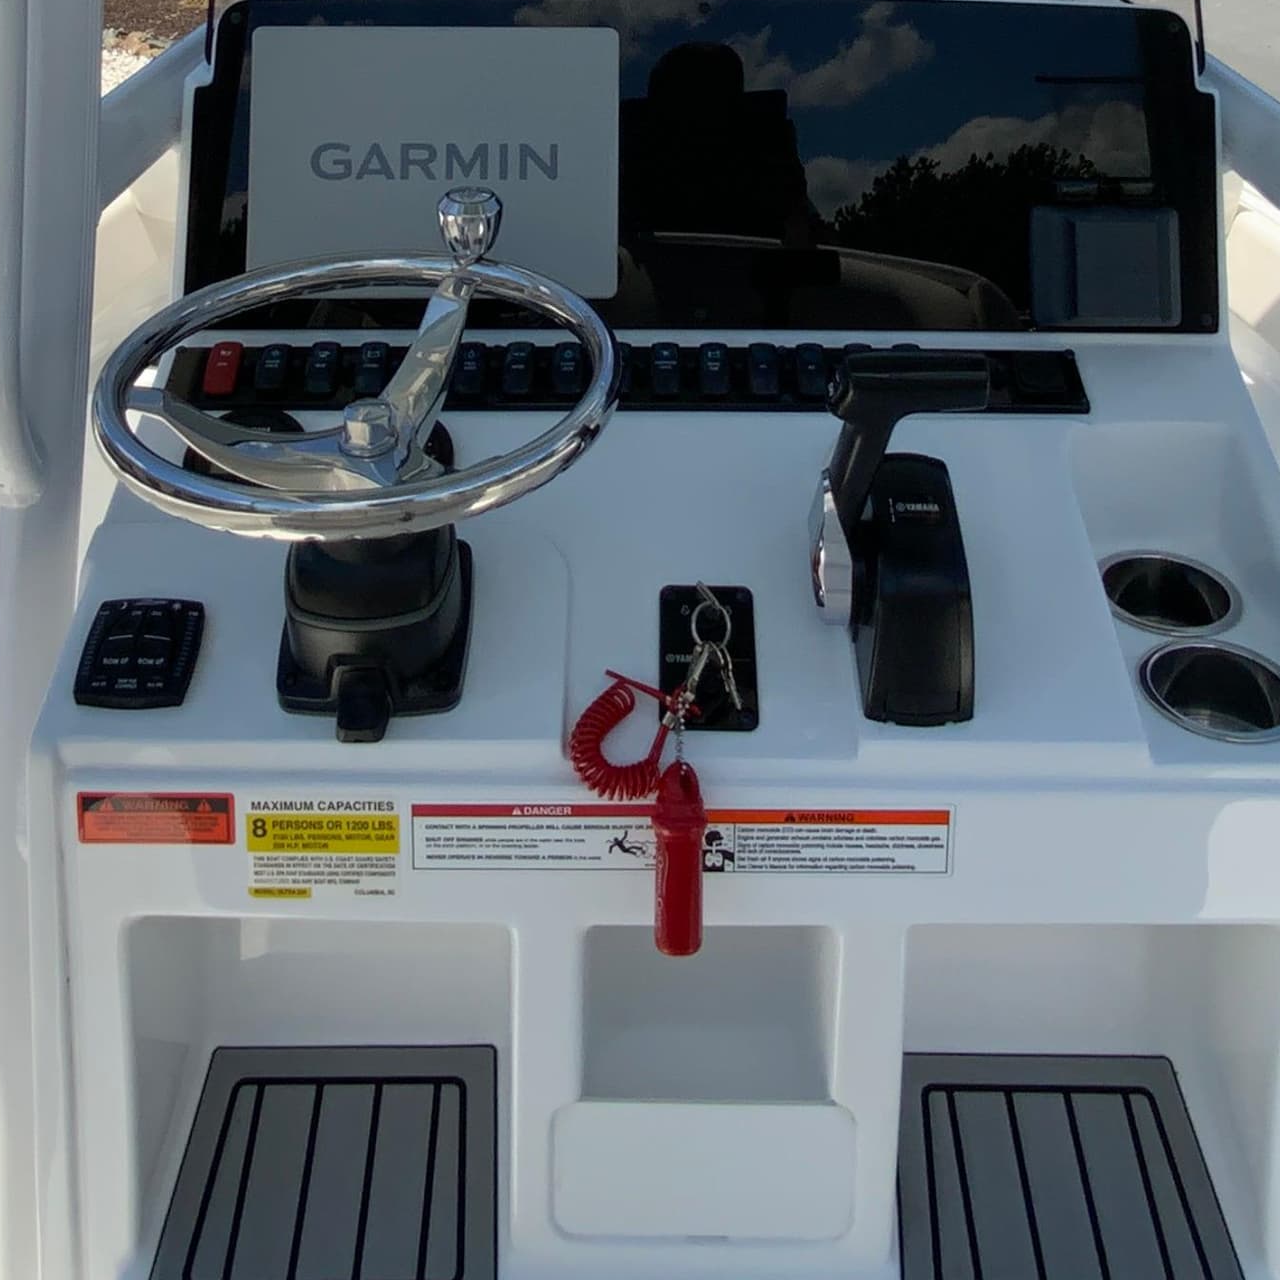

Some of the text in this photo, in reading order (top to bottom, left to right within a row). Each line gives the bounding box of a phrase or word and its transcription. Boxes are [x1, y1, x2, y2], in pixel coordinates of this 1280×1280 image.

[310, 142, 559, 181] GARMIN
[905, 503, 940, 512] YAMAHA
[251, 801, 395, 811] MAXIMUM CAPACITIES
[524, 806, 572, 815] DANGER
[798, 813, 854, 822] WARNING
[252, 818, 267, 838] 8
[272, 820, 396, 831] PERSONS OR 1200 LBS.
